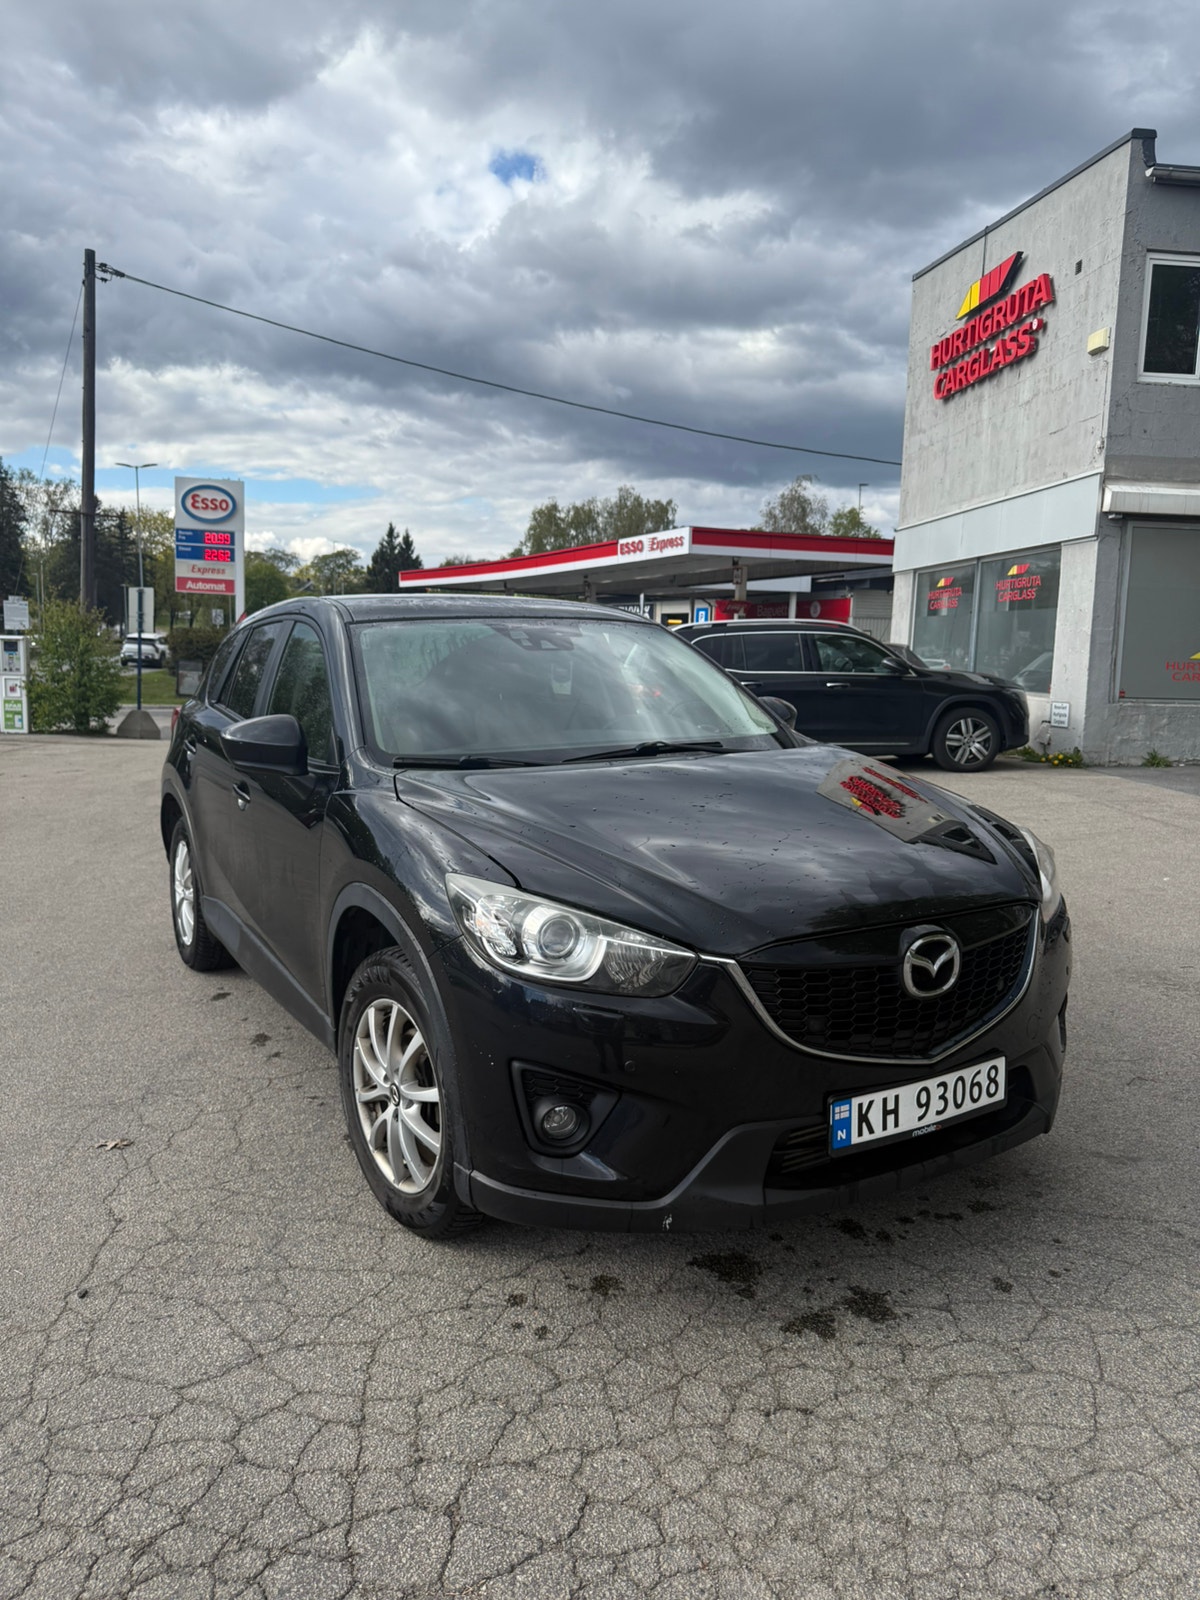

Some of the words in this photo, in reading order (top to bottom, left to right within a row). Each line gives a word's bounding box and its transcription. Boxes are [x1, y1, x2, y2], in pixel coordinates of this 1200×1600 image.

[930, 273, 1053, 371] HURTIGRUTA
[191, 493, 229, 511] Esso
[620, 540, 643, 555] ESSO
[648, 536, 684, 553] Express
[191, 564, 226, 575] Express
[186, 581, 226, 592] Automat
[995, 575, 1041, 590] HURTIGRUTA
[928, 587, 962, 599] HURTIGRUTA
[998, 588, 1036, 602] CARGLASS
[1166, 661, 1200, 671] HUR
[857, 1094, 899, 1138] KH
[916, 1064, 999, 1122] 93068
[837, 1129, 846, 1141] N
